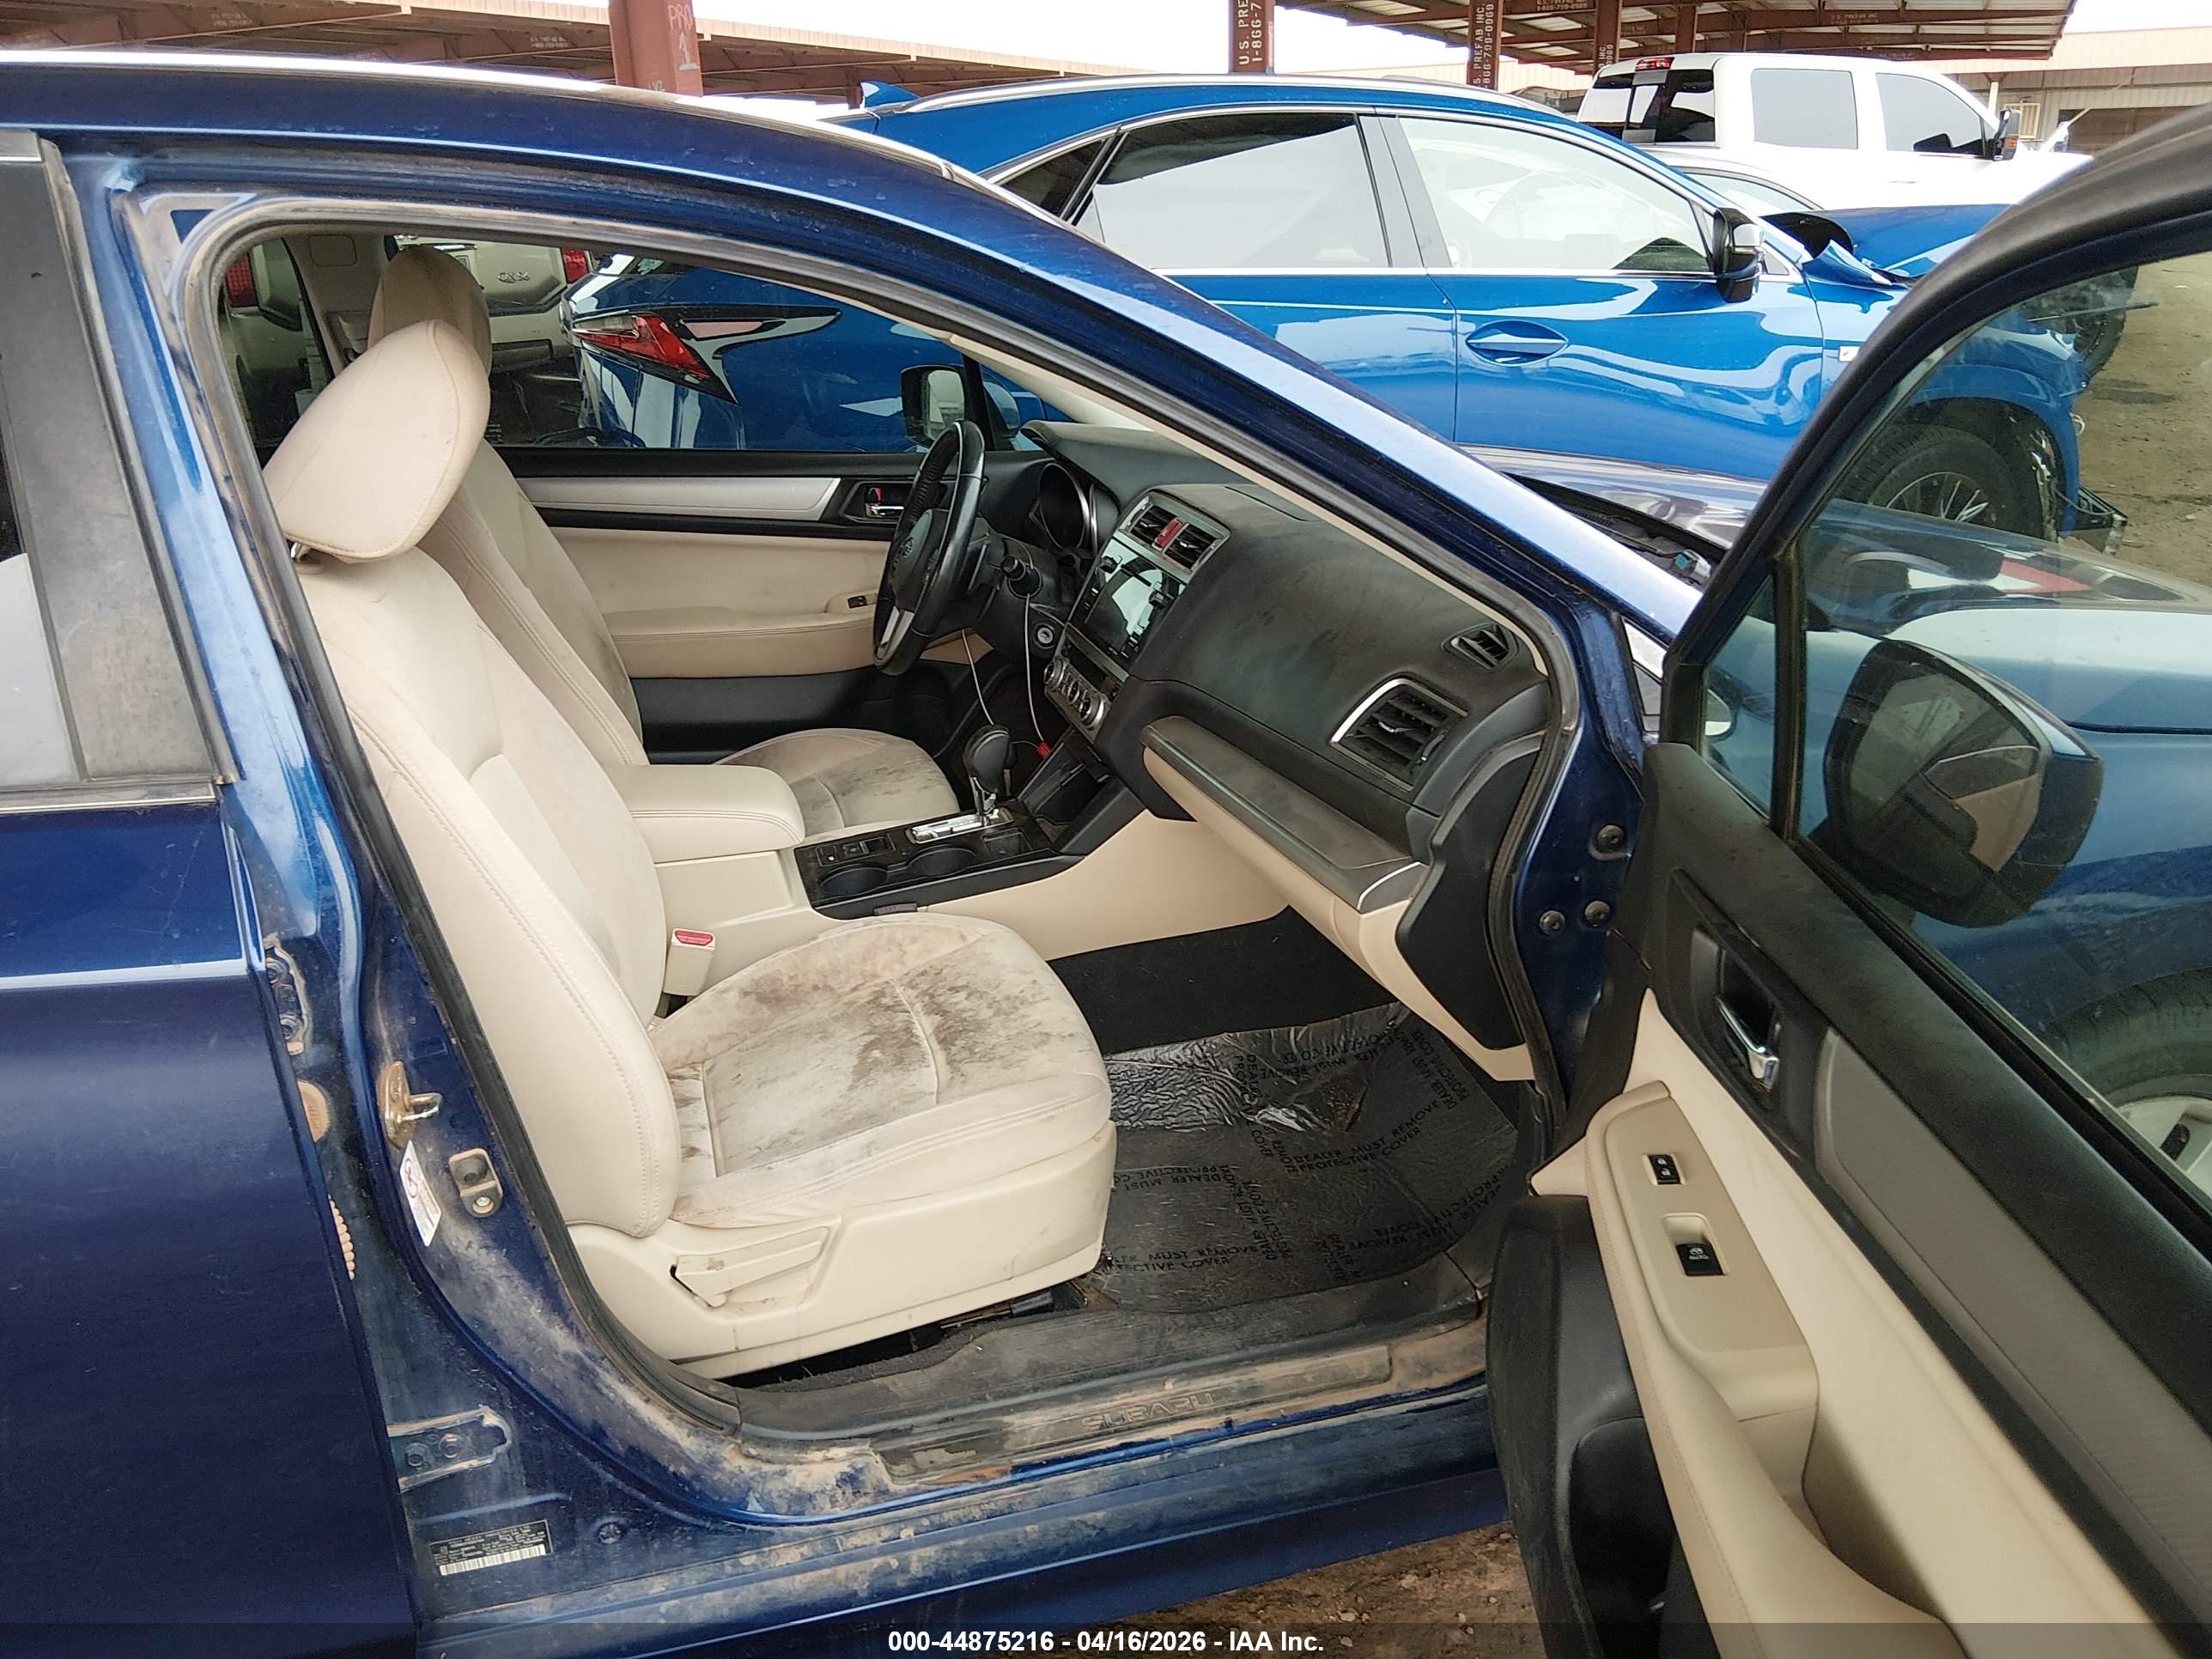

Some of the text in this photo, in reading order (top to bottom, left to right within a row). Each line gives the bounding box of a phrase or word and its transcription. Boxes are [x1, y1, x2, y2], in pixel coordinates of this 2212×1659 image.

[1238, 36, 1250, 65] U.S.
[1474, 28, 1483, 70] PREFAB
[1293, 1099, 1439, 1164] DEALER MUST REMOVE
[1299, 1125, 1422, 1172] PROTECTIVE COVER
[1170, 1173, 1221, 1183] DEALER
[1149, 1250, 1188, 1261] MUST
[1083, 1393, 1213, 1430] SUBARU
